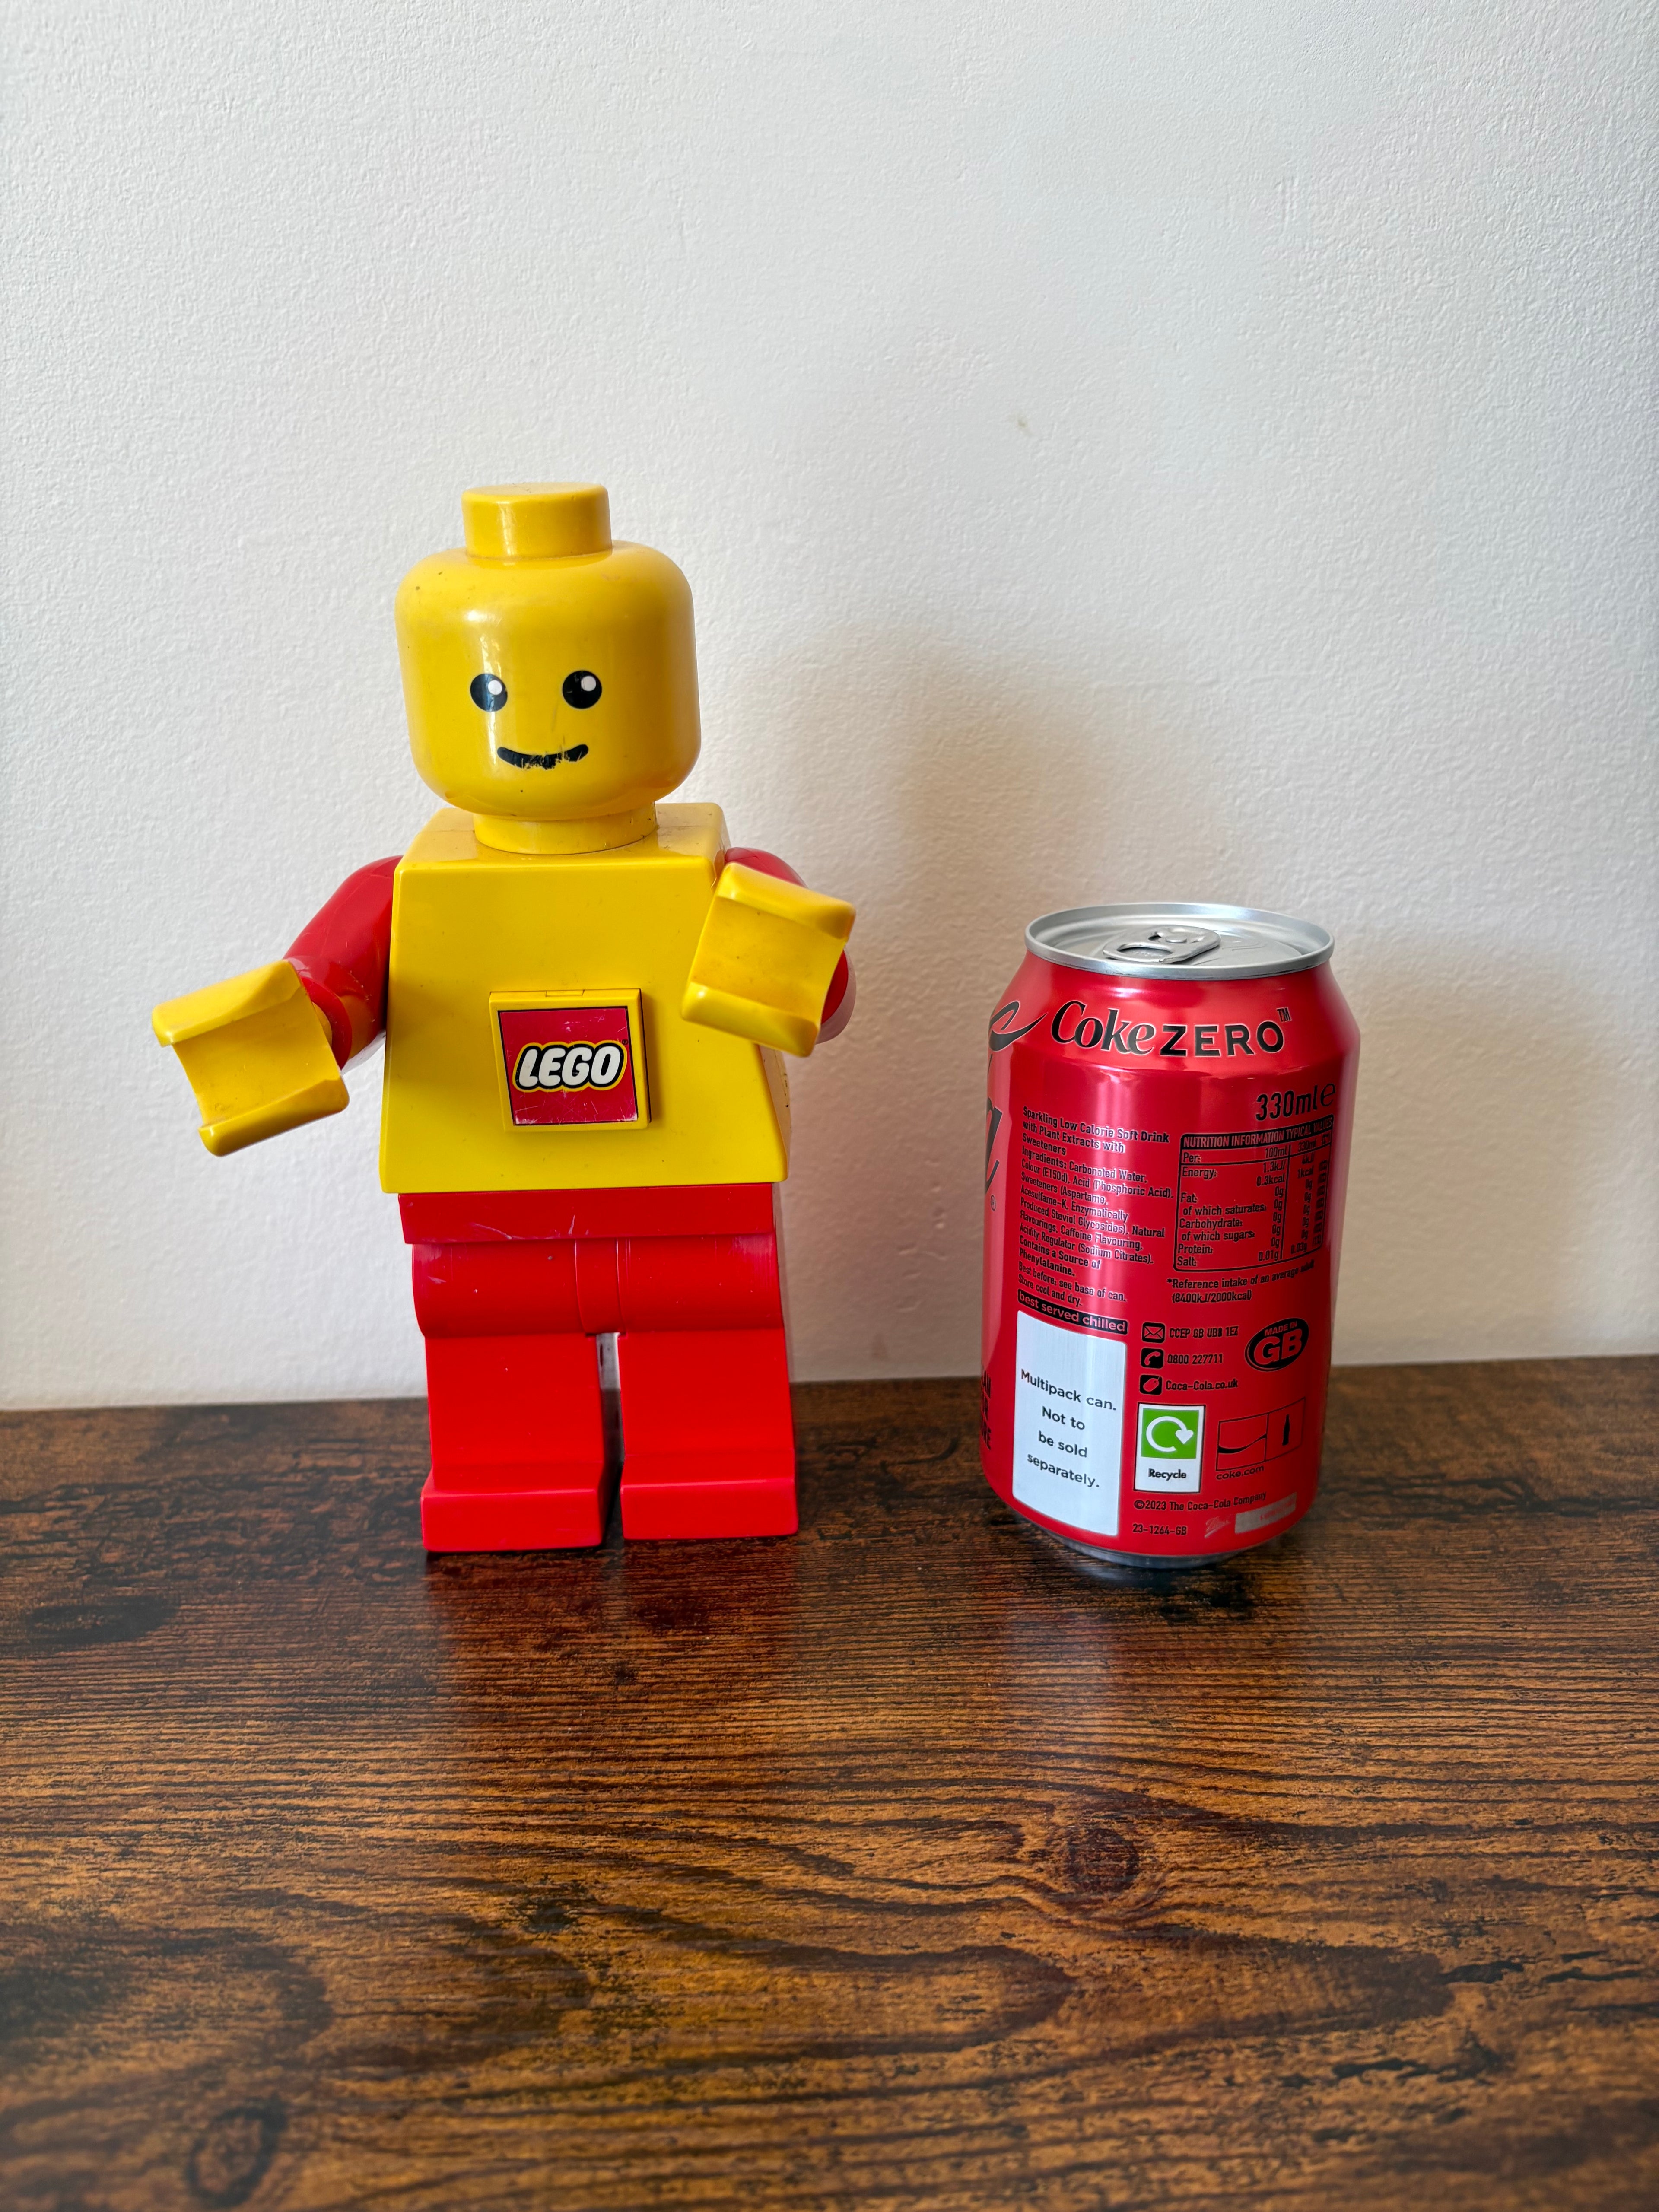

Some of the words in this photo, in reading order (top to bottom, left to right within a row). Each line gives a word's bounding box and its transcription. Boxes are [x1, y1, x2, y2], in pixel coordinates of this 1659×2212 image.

[1051, 1000, 1156, 1056] Coke
[515, 1042, 624, 1090] LEGO
[1023, 1106, 1058, 1128] Sparkling
[1060, 1118, 1077, 1130] Low
[1080, 1123, 1113, 1137] Calorie
[1117, 1128, 1138, 1140] Soft
[1141, 1131, 1169, 1143] Drink
[1023, 1121, 1037, 1133] with
[1039, 1127, 1059, 1140] Plant
[1062, 1132, 1099, 1148] Extracts
[1103, 1141, 1125, 1153] with
[1023, 1133, 1066, 1155] Sweeteners
[1183, 1135, 1229, 1147] NUTRITION
[1231, 1131, 1284, 1146] INFORMATION
[1286, 1124, 1311, 1140] TYPICAL
[1022, 1146, 1067, 1169] Ingredients:
[1069, 1161, 1116, 1179] Carbonated
[1183, 1152, 1201, 1163] Per:
[1265, 1147, 1287, 1158] 100ml
[1022, 1159, 1040, 1173] Colour
[1073, 1176, 1089, 1187] Acid
[1093, 1180, 1144, 1196] (Phosphoric
[1182, 1167, 1217, 1180] Energy:
[1263, 1161, 1286, 1173] 1.3kJ/
[1256, 1174, 1285, 1187] 0.3kcal
[1021, 1172, 1058, 1192] Sweeteners
[1180, 1192, 1197, 1203] Fat:
[1275, 1187, 1283, 1197] 0g
[1020, 1198, 1049, 1216] Produced
[1052, 1209, 1075, 1224] Steviol
[1132, 1226, 1165, 1237] Natural
[1071, 1201, 1128, 1222] Enzymatically
[1183, 1206, 1192, 1215] of
[1195, 1205, 1222, 1215] which
[1225, 1203, 1266, 1214] saturates:
[1274, 1200, 1283, 1210] 0g
[1179, 1218, 1243, 1230] Carbohydrate:
[1273, 1212, 1281, 1223] 0g
[1061, 1225, 1092, 1241] Caffeine
[1181, 1232, 1190, 1241] of
[1193, 1231, 1220, 1241] which
[1223, 1230, 1255, 1242] sugars:
[1272, 1224, 1281, 1236] 0g
[1020, 1223, 1039, 1240] Acidity
[1042, 1232, 1075, 1250] Regulator
[1078, 1243, 1111, 1258] (Sodium
[1114, 1250, 1153, 1264] Citrates).
[1020, 1235, 1049, 1255] Contains
[1052, 1249, 1055, 1258] a
[1058, 1250, 1088, 1266] Source
[1091, 1259, 1101, 1268] of
[1178, 1244, 1213, 1254] Protein:
[1271, 1237, 1279, 1248] 0g
[1019, 1248, 1075, 1276] Phenylalanine.
[1177, 1256, 1197, 1266] Salt:
[1258, 1251, 1278, 1261] 0.01g
[1019, 1261, 1031, 1274] Best
[1033, 1268, 1057, 1285] before:
[1059, 1280, 1072, 1290] see
[1075, 1282, 1093, 1295] base
[1097, 1288, 1106, 1297] of
[1108, 1291, 1127, 1301] can.
[1222, 1278, 1247, 1287] intake
[1250, 1275, 1258, 1284] of
[1260, 1275, 1269, 1283] an
[1271, 1269, 1298, 1281] average
[1018, 1274, 1033, 1289] Store
[1036, 1284, 1050, 1296] cool
[1052, 1290, 1065, 1300] and
[1068, 1294, 1082, 1307] dry.
[1173, 1290, 1252, 1303] (8400kJ/2000kcal)
[1019, 1291, 1039, 1308] best
[1042, 1302, 1079, 1322] served
[1083, 1316, 1126, 1332] chilled
[1170, 1328, 1190, 1338] CCEP
[1193, 1328, 1204, 1338] GB
[1265, 1325, 1283, 1336] MADE
[1284, 1321, 1297, 1331] IN
[1254, 1329, 1302, 1365] GB
[1167, 1354, 1189, 1364] 0800
[1192, 1353, 1222, 1364] 227711
[1021, 1368, 1081, 1403] Multipack
[1086, 1397, 1116, 1411] can.
[1166, 1378, 1238, 1390] Coca-Cola.co.uk
[1042, 1406, 1066, 1424] Not
[1070, 1417, 1085, 1430] to
[1039, 1430, 1054, 1446] be
[1058, 1441, 1087, 1458] sold
[1027, 1454, 1100, 1487] separately.
[1148, 1468, 1186, 1480] Recycle
[1216, 1465, 1264, 1480] coke.com
[1170, 1501, 1184, 1510] The
[1188, 1498, 1231, 1511] Coca-Cola
[1233, 1491, 1266, 1506] Company
[1133, 1523, 1187, 1535] 23-1264-GB
